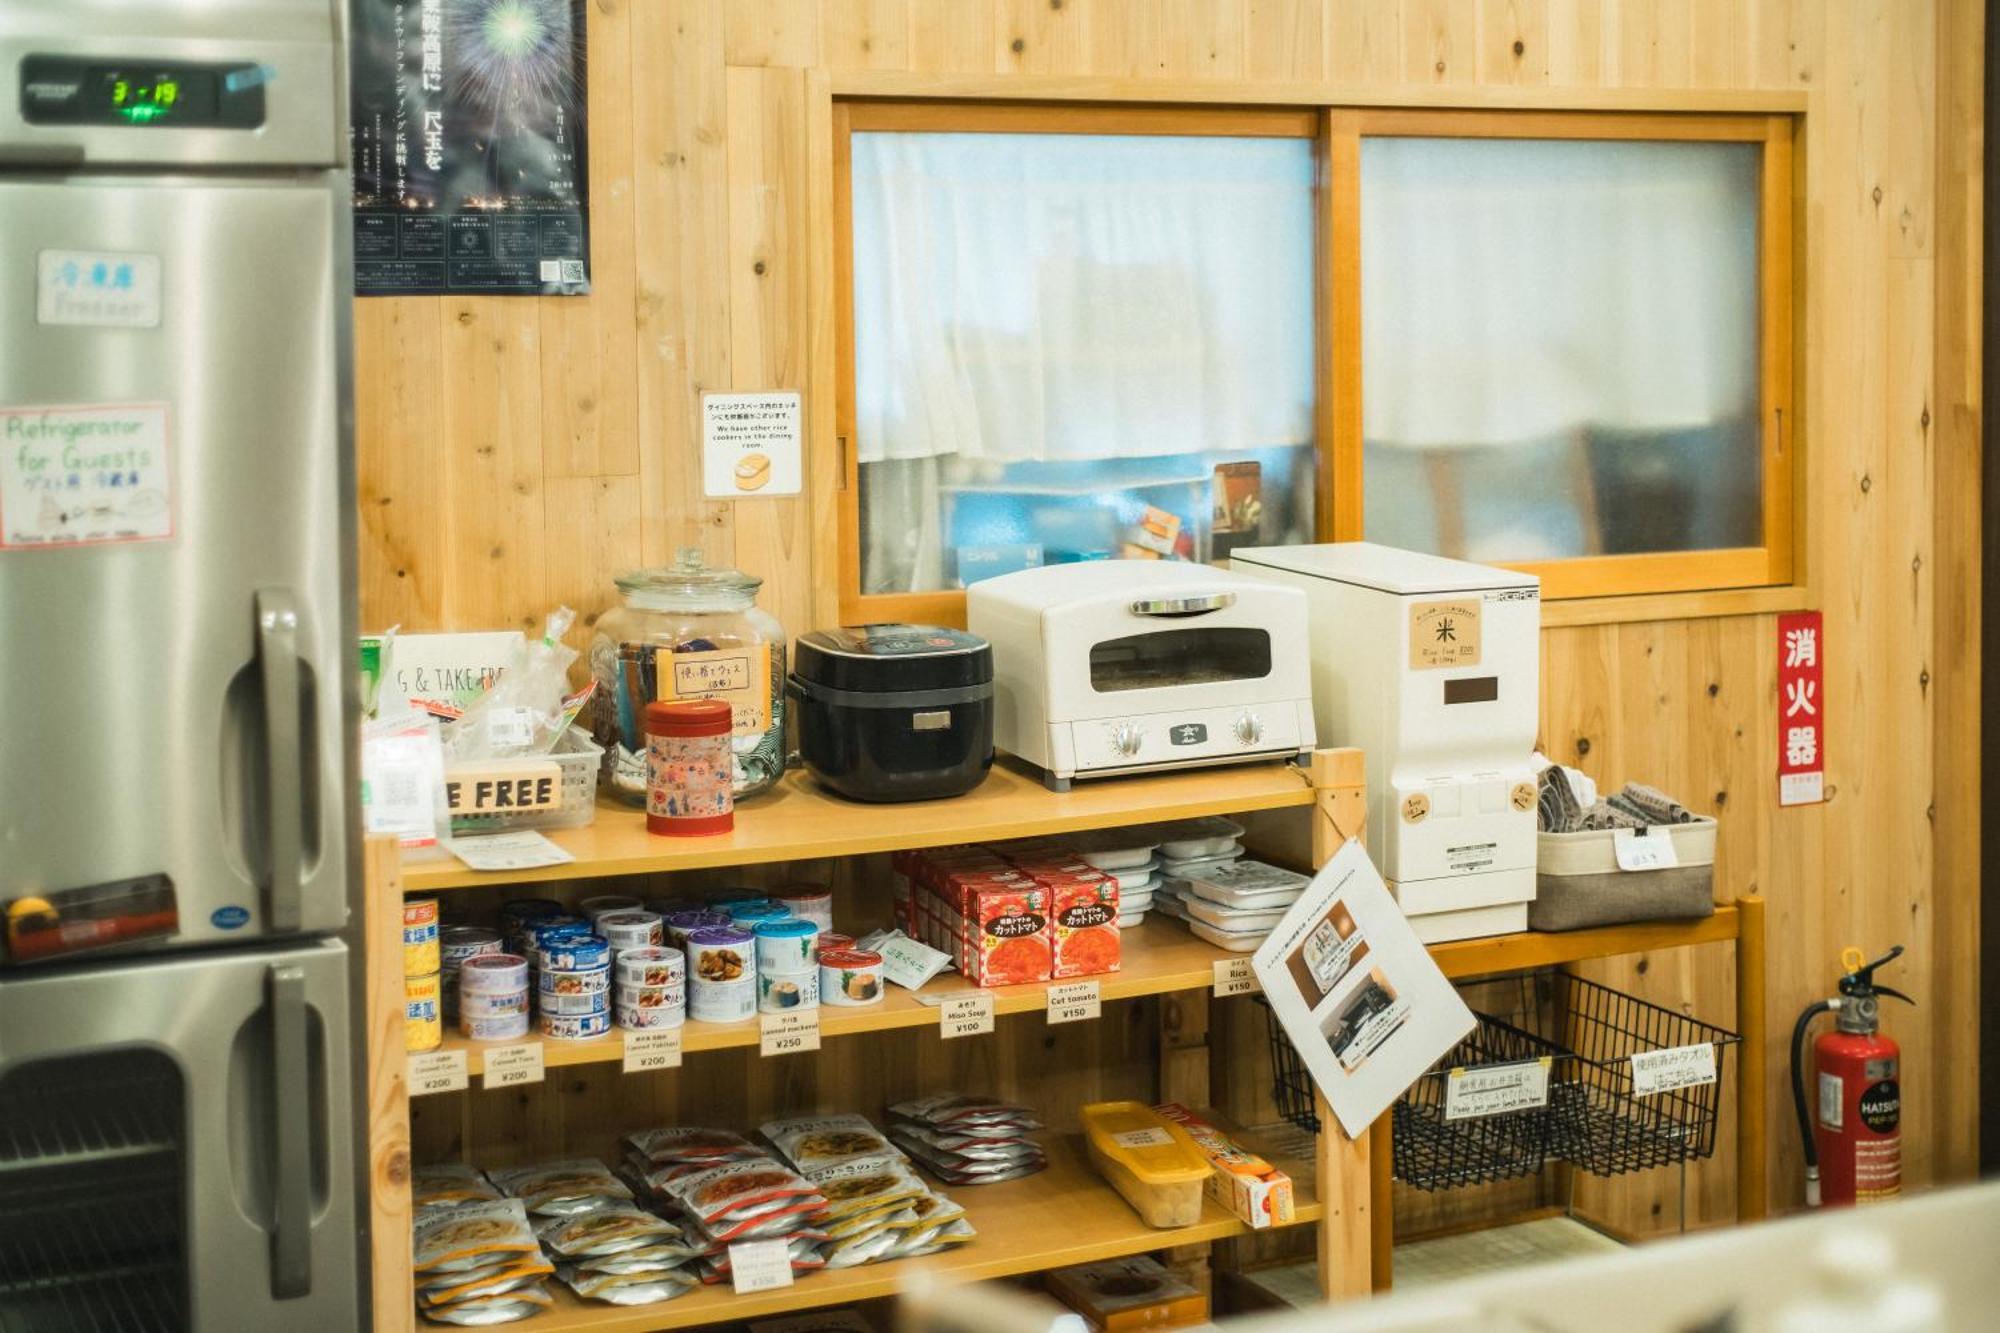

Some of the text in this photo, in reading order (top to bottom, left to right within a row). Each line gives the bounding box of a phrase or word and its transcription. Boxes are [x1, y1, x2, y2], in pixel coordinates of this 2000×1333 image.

[1435, 617, 1456, 643] 米
[435, 667, 474, 692] TAKE
[1785, 628, 1816, 766] 消火器
[476, 778, 554, 808] FREE
[1066, 912, 1109, 926] カットトマト
[994, 922, 1039, 935] カットトマト
[1230, 970, 1248, 978] Rice
[1228, 982, 1250, 992] ¥150
[1051, 993, 1097, 1006] Cut tomato
[947, 1009, 987, 1020] Miso Soup
[1063, 1008, 1086, 1019] ¥150
[956, 1022, 980, 1033] ¥100
[775, 1038, 801, 1049] ¥250
[640, 1056, 666, 1067] ¥200
[501, 1070, 527, 1082] ¥200
[425, 1077, 451, 1089] ¥200
